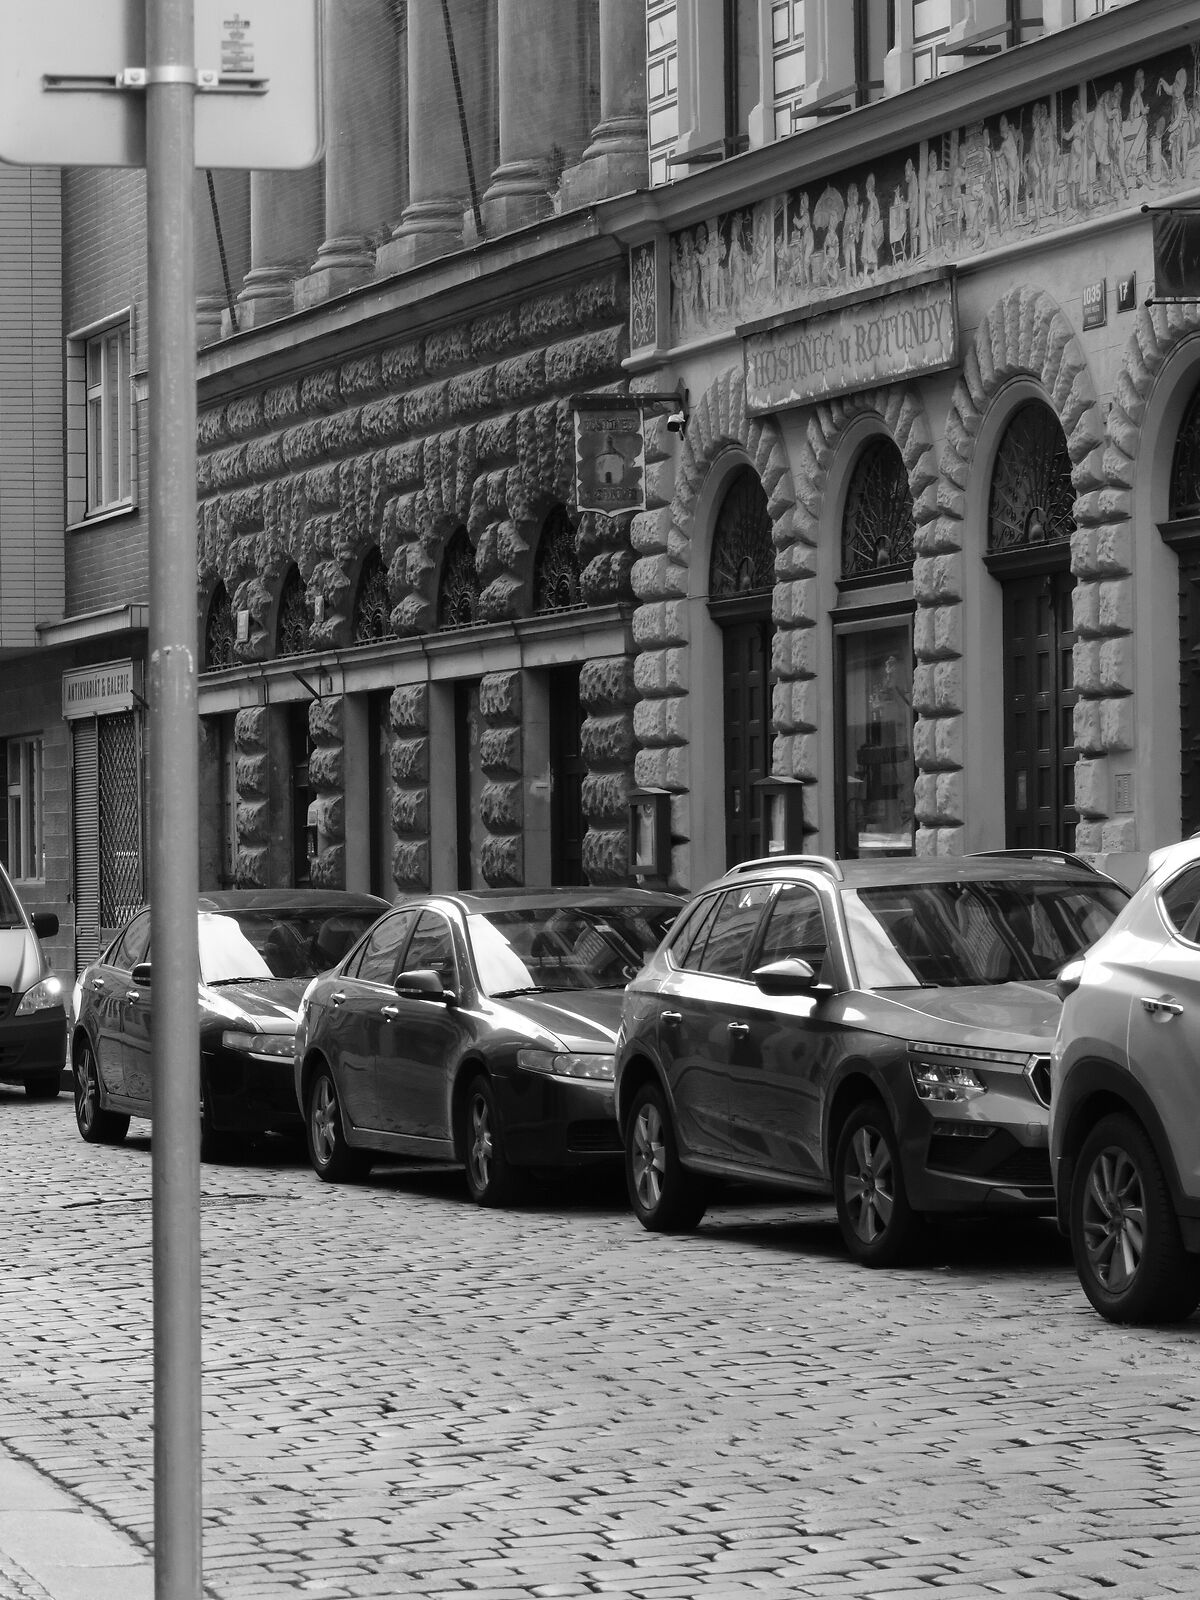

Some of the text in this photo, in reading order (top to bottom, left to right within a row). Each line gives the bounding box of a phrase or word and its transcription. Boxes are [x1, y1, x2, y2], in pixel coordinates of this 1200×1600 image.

[1083, 283, 1101, 306] 1035
[1119, 281, 1128, 301] 17
[753, 329, 836, 389] HOSTINEC
[854, 300, 951, 365] ROTUNDY
[68, 674, 129, 702] ANTIKVARIÁT & GALERIE
